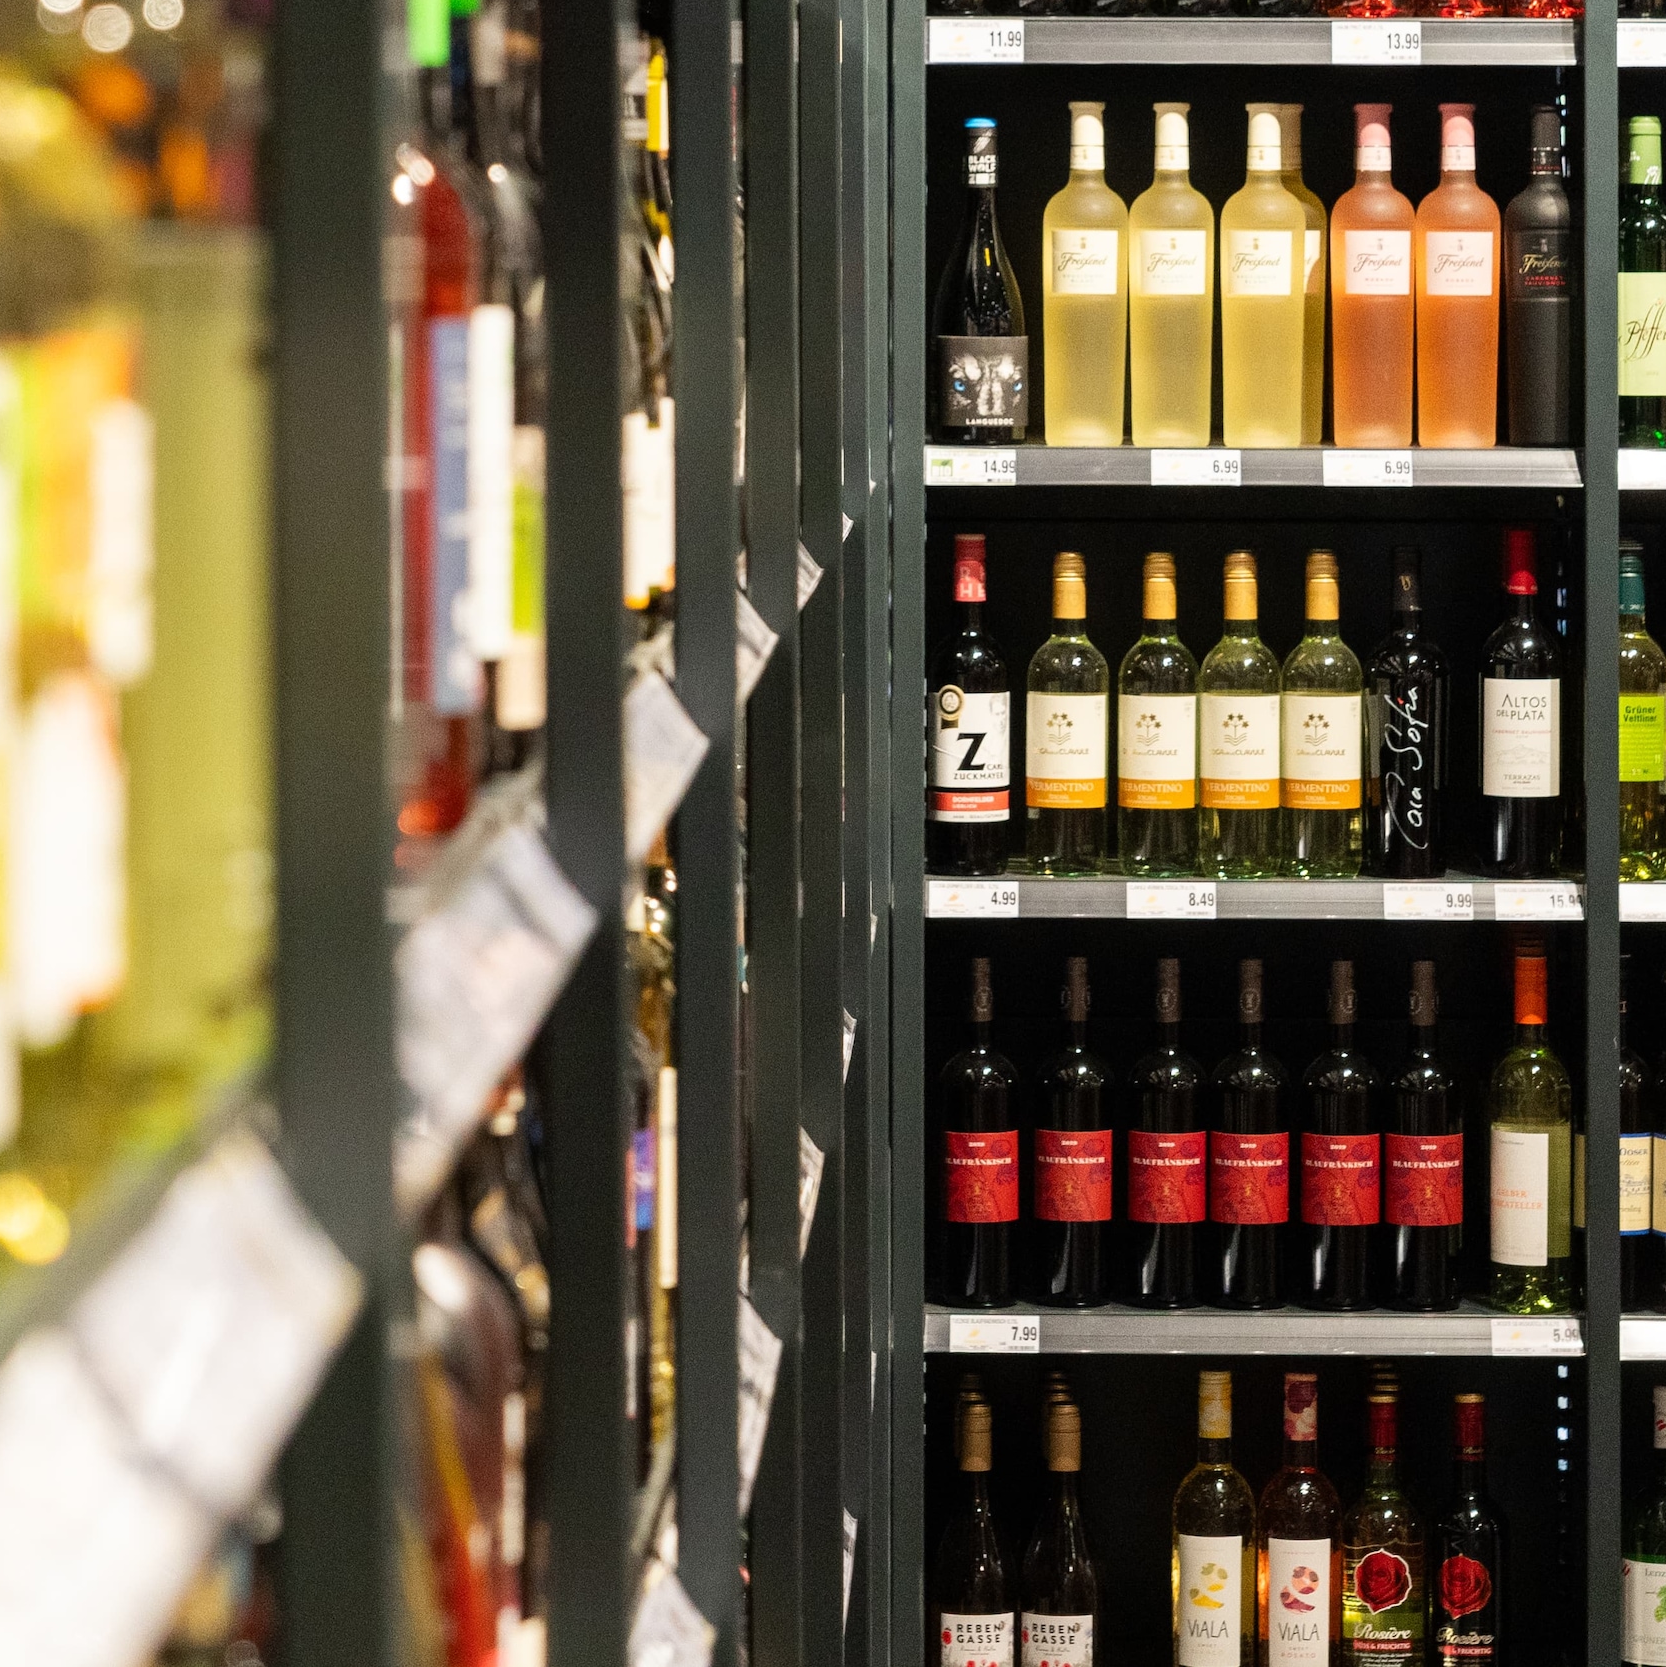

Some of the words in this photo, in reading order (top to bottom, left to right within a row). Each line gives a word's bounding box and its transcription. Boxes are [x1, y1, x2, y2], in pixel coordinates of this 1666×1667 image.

[990, 32, 1022, 47] 11.99
[1387, 33, 1419, 50] 13.99
[1354, 254, 1402, 272] Freixenet
[1435, 254, 1484, 273] Freixenet
[1213, 460, 1238, 473] 6.99
[1502, 694, 1547, 708] ALTOS
[1497, 710, 1509, 718] DEL
[1511, 711, 1545, 721] PLATA
[1625, 706, 1656, 714] Grüner
[1624, 713, 1657, 723] Veltliner
[957, 733, 987, 770] Z
[991, 892, 1016, 905] 4.99
[1393, 1160, 1459, 1168] BLAUFRÄNKISCH
[957, 1624, 1002, 1633] REBEN
[1033, 1623, 1075, 1633] REBEN
[1354, 1623, 1412, 1640] Rosière
[957, 1635, 1001, 1644] GASSE
[1032, 1635, 1075, 1644] GASSE
[1377, 1641, 1410, 1650] FRUCHTIG
